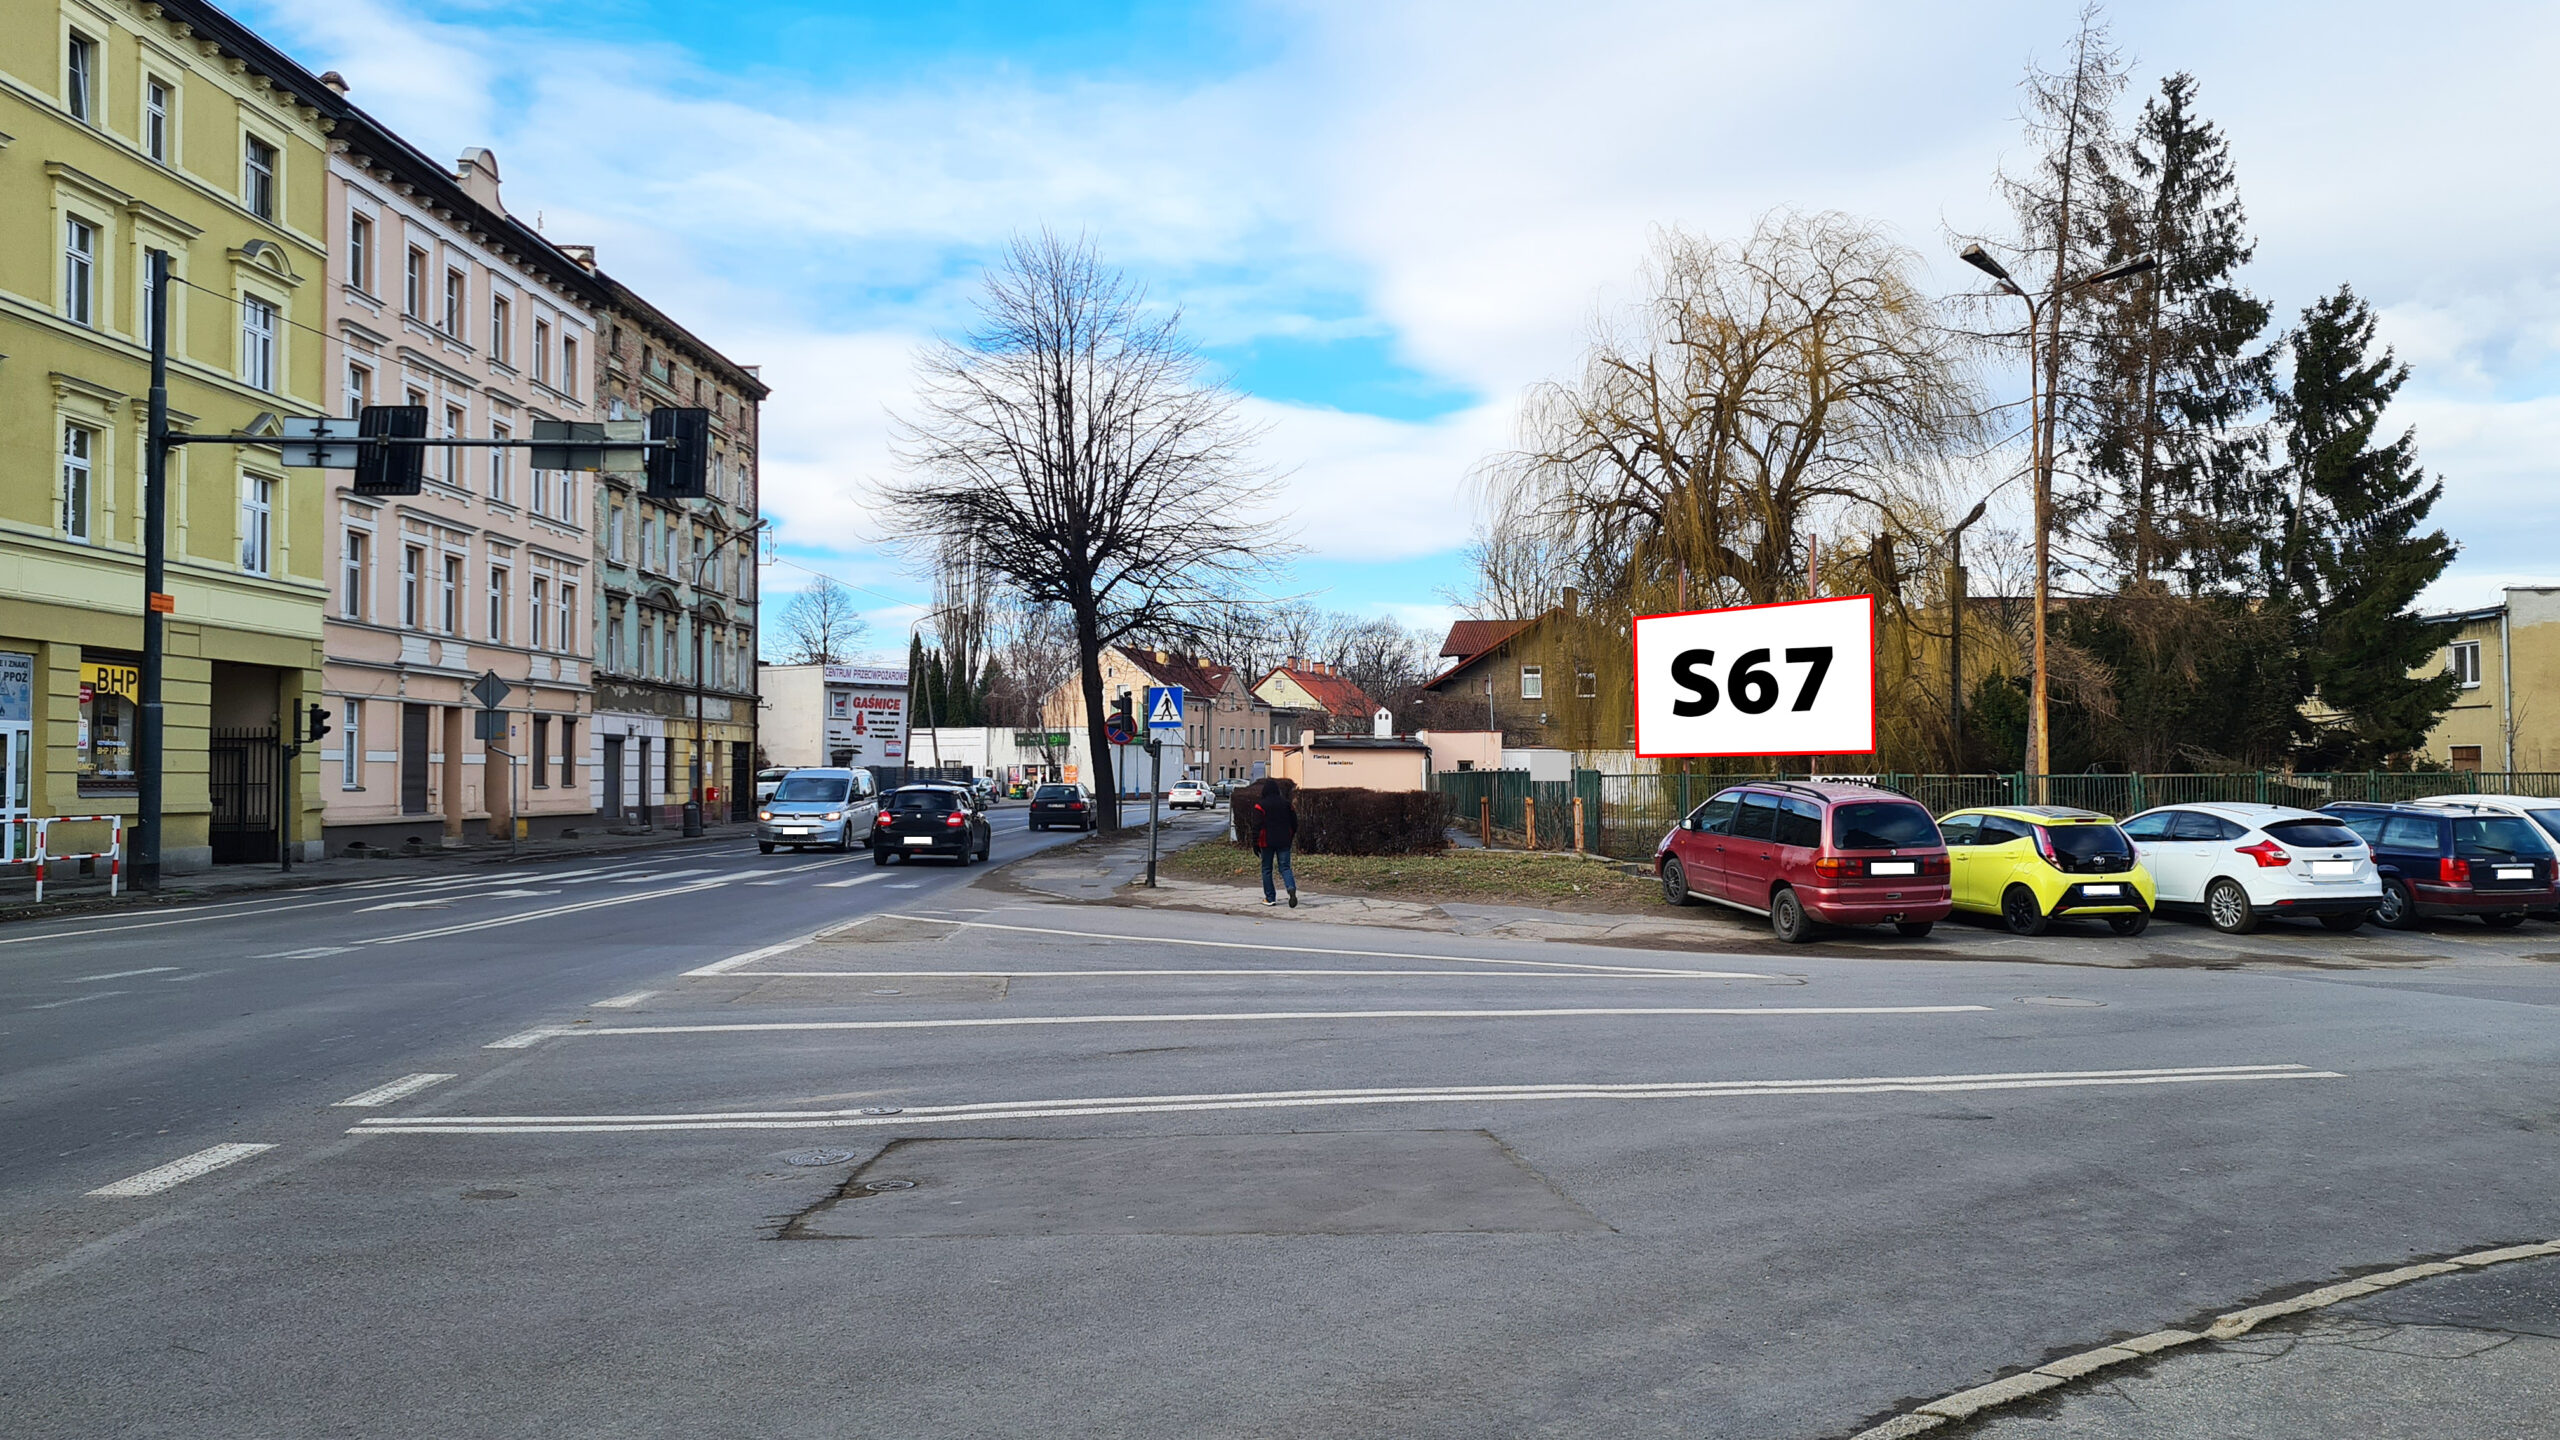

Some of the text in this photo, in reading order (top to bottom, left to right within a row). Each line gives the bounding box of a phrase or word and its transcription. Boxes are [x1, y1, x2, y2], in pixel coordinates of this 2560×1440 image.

[9, 660, 28, 668] ZNAKI
[825, 667, 851, 678] CENTRUM
[97, 667, 138, 693] BHP
[853, 694, 901, 710] GAŚNICE
